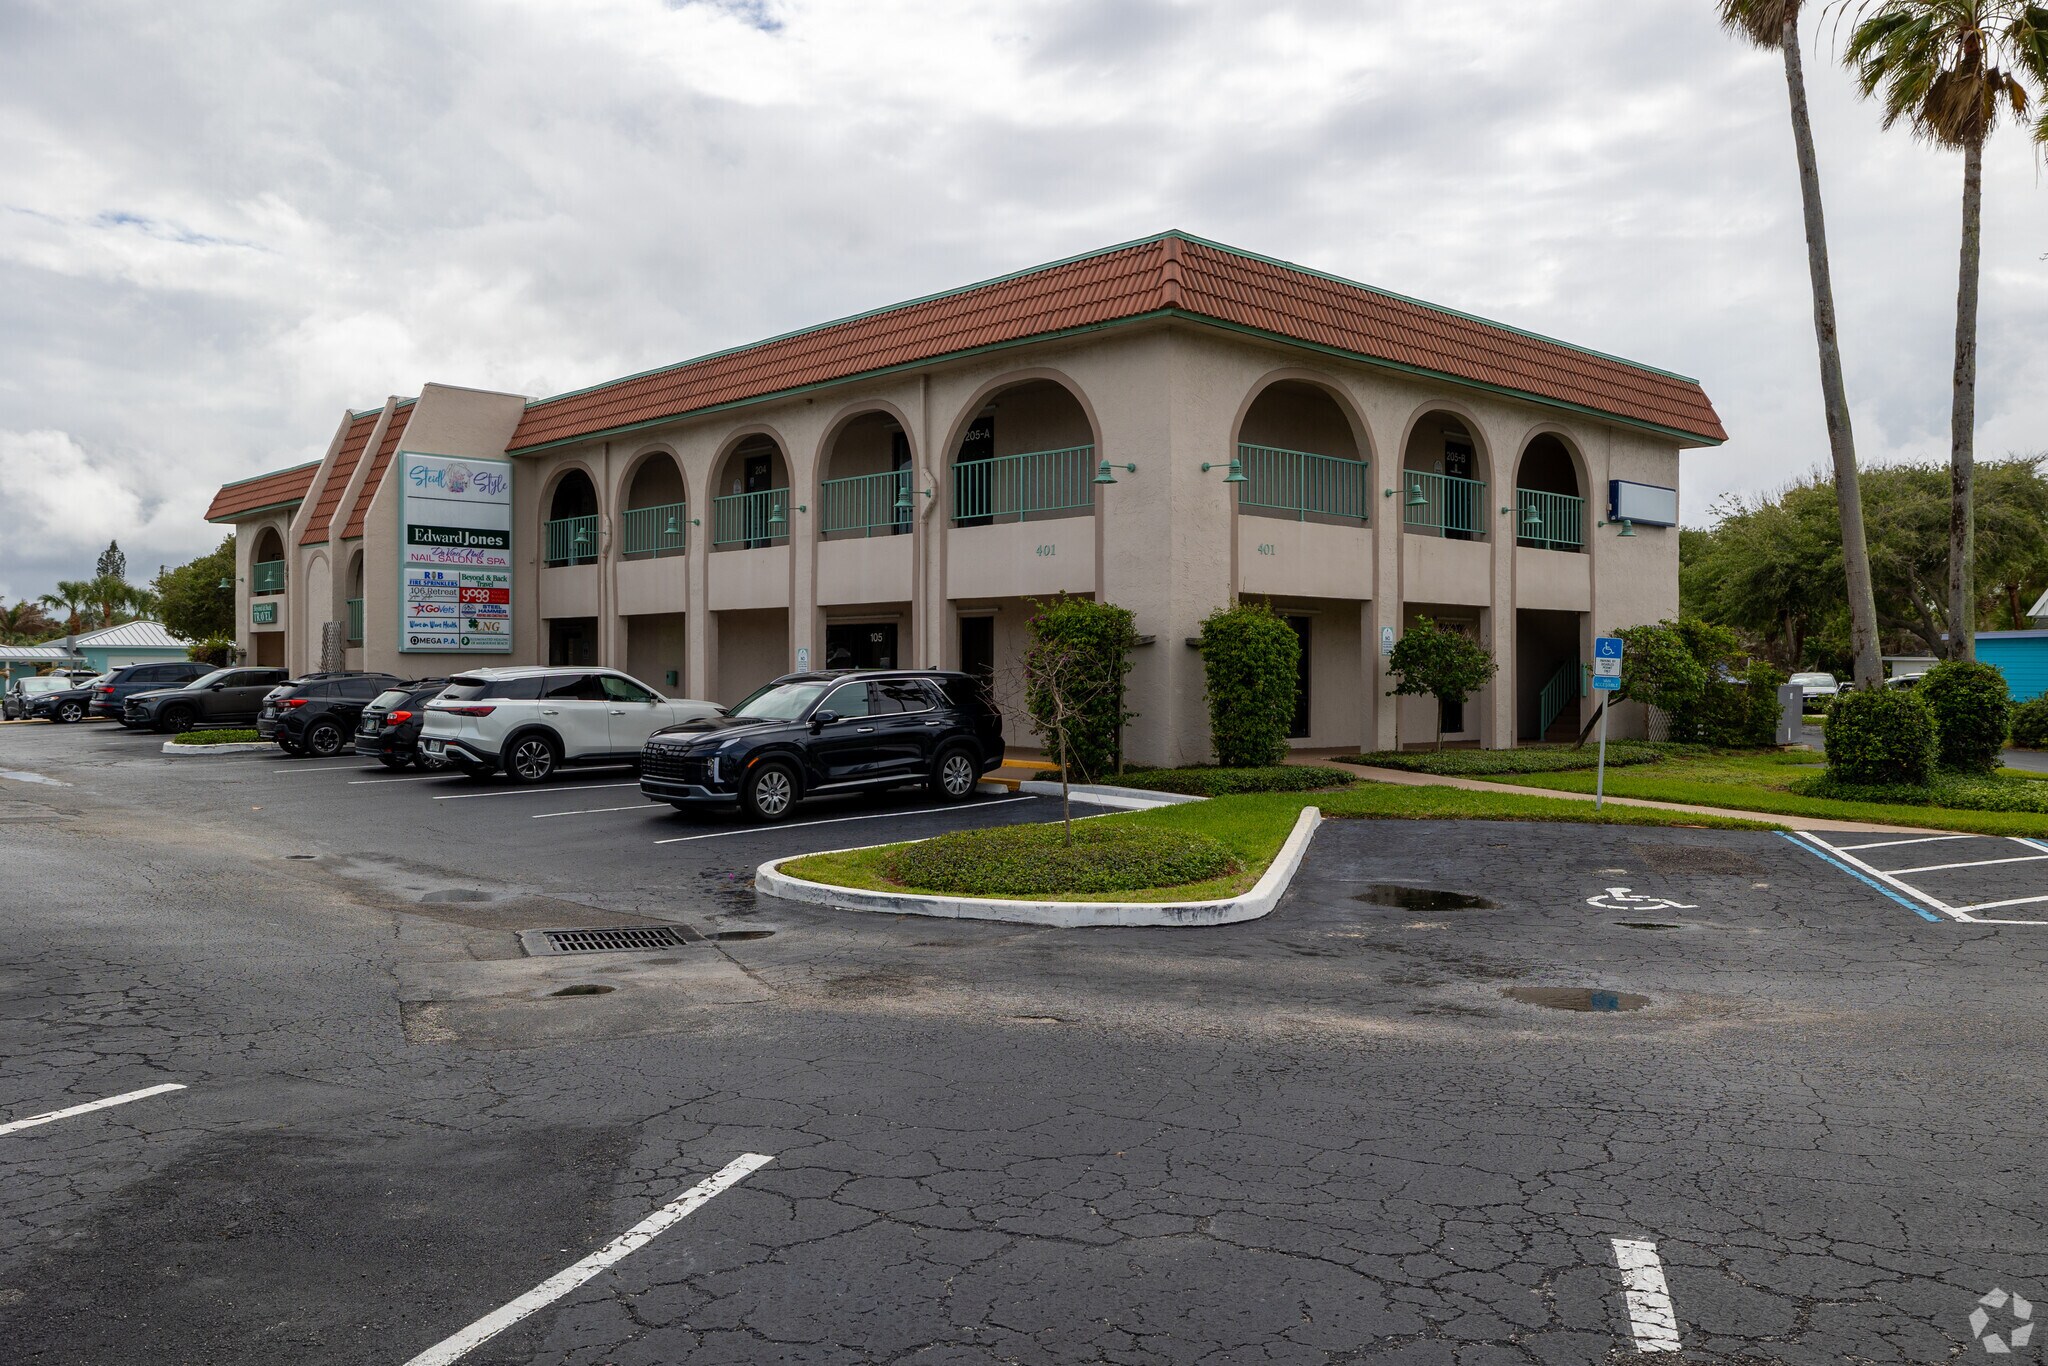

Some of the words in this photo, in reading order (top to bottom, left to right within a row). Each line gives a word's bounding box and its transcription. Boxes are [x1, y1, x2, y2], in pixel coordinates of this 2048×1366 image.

[965, 428, 990, 441] 205-A
[755, 464, 767, 475] 204
[409, 465, 446, 489] Steidl
[473, 471, 508, 496] Style
[414, 528, 463, 544] Edward
[463, 531, 504, 546] Jones
[1036, 544, 1056, 556] 401
[1257, 543, 1276, 556] 401
[411, 553, 434, 562] NAIL
[438, 555, 473, 564] SALON
[477, 557, 485, 565] &
[487, 557, 506, 565] SPA
[461, 573, 485, 582] Beyond
[485, 574, 492, 582] &
[411, 587, 426, 595] 106
[427, 587, 457, 595] Retreat
[425, 604, 455, 614] GoVets
[475, 621, 500, 632] LNG
[410, 636, 442, 645] OMEGA
[443, 637, 458, 645] P.A.
[870, 632, 883, 642] 105
